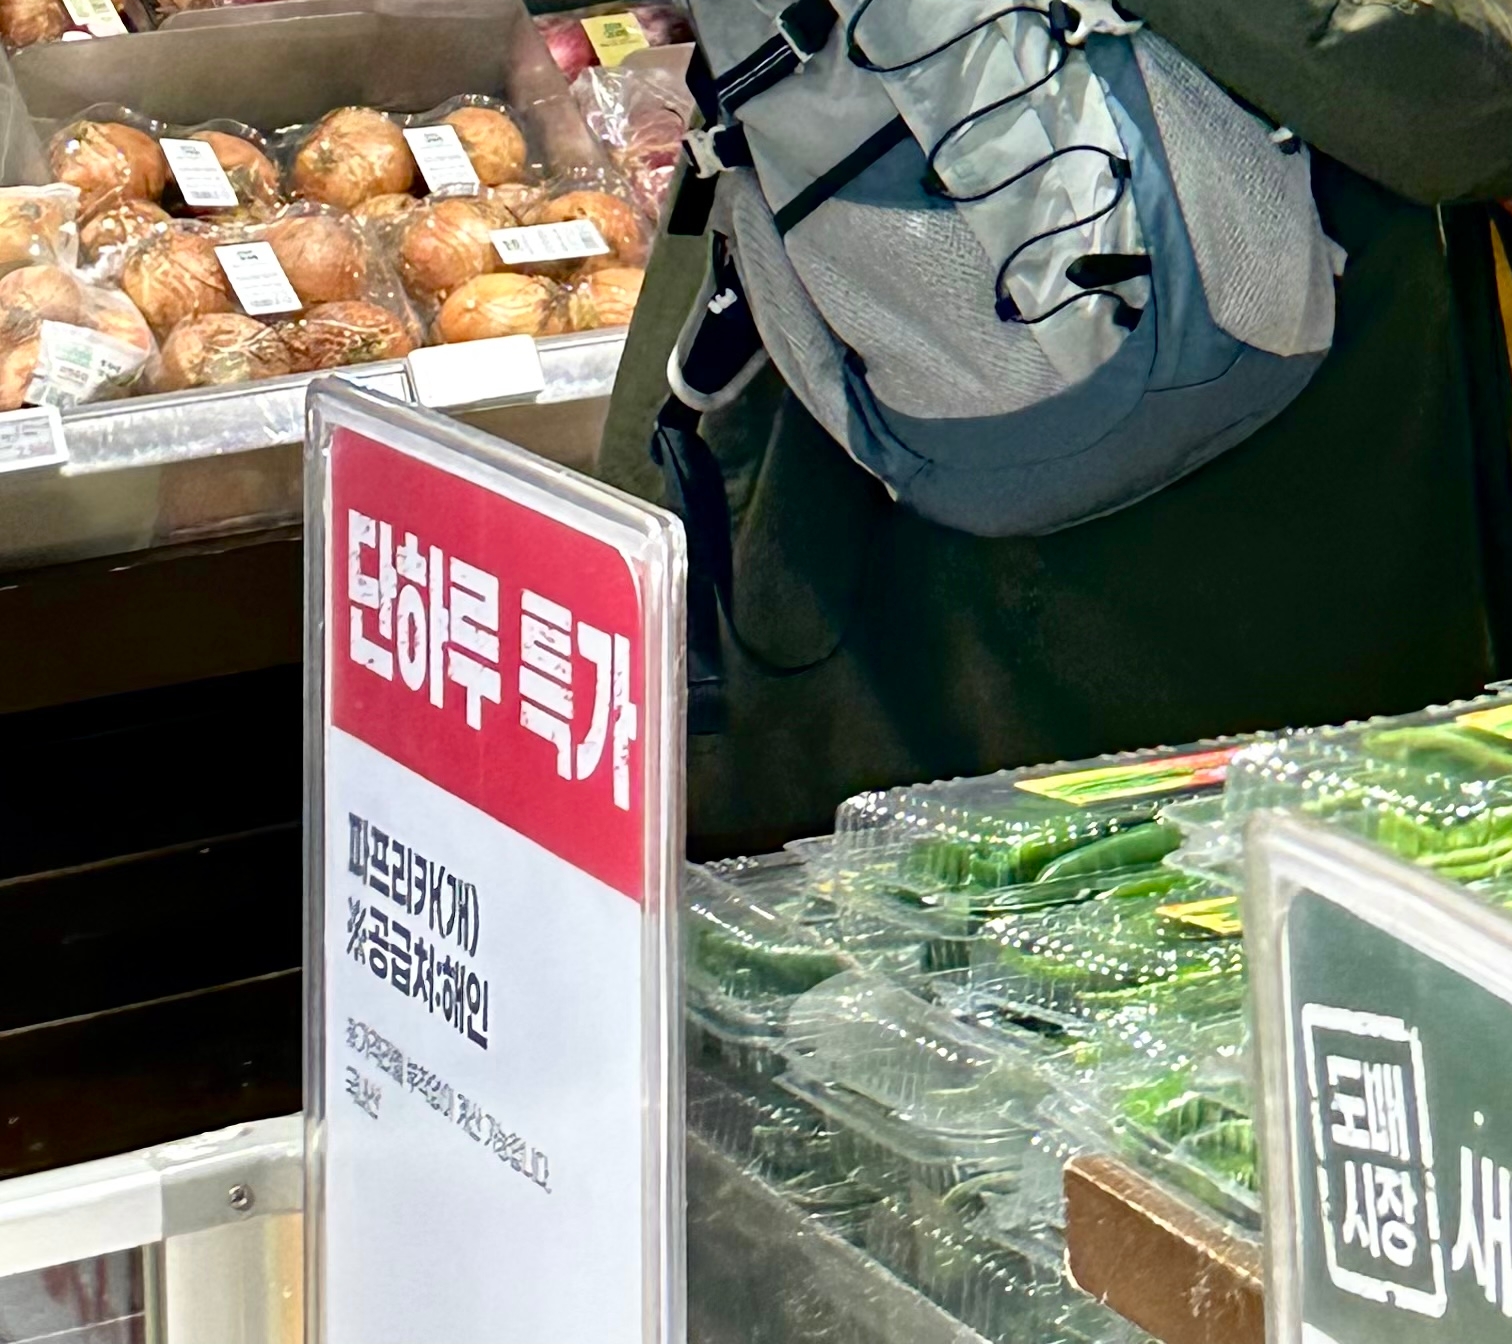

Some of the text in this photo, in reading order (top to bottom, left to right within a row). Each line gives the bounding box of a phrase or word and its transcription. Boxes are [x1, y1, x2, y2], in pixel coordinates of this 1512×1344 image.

[348, 508, 637, 811] 단하루 특가
[1343, 1159, 1416, 1268] 시장
